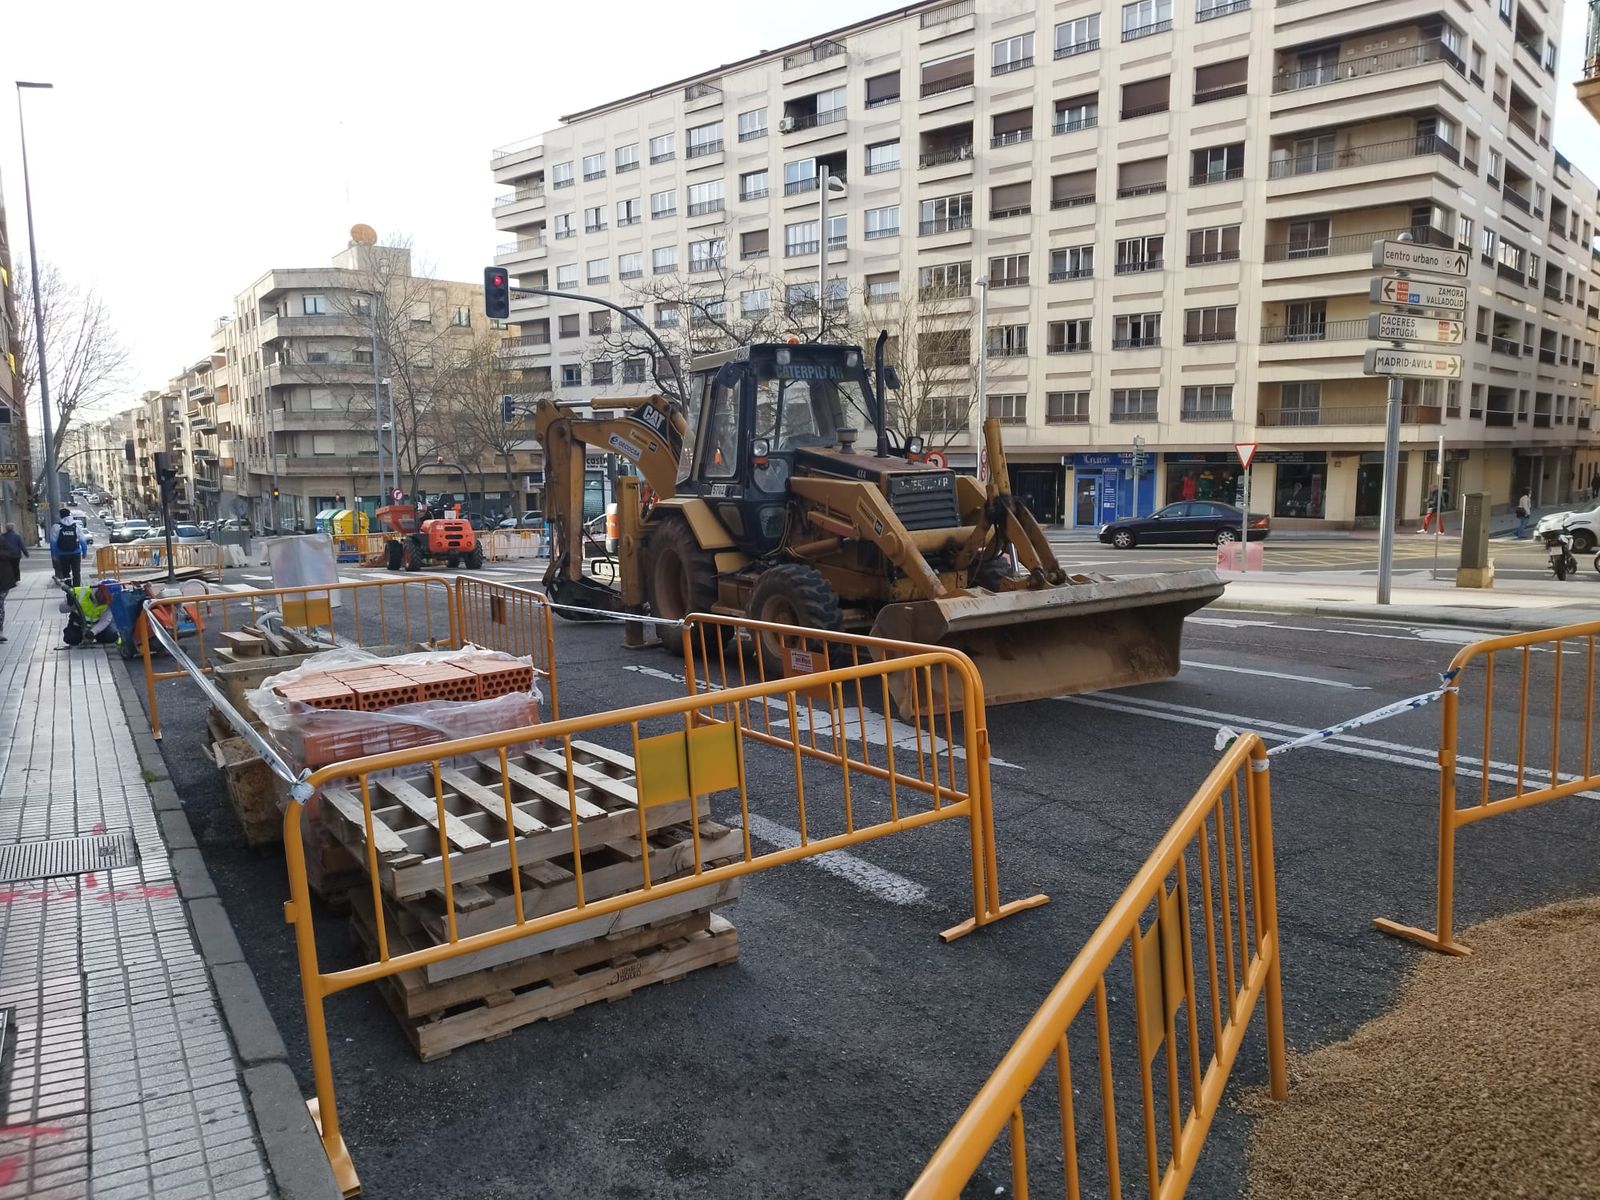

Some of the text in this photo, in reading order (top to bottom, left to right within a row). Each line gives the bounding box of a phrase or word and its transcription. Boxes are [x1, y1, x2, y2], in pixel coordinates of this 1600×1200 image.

[1385, 249, 1439, 265] centro urbano
[1438, 287, 1464, 298] ZAMORA
[1426, 295, 1464, 307] VALLADOLID
[1381, 315, 1416, 328] CACERES
[1381, 326, 1418, 338] PORTUGAL
[1377, 356, 1433, 369] MADRID-AVILA
[642, 405, 666, 430] CAT
